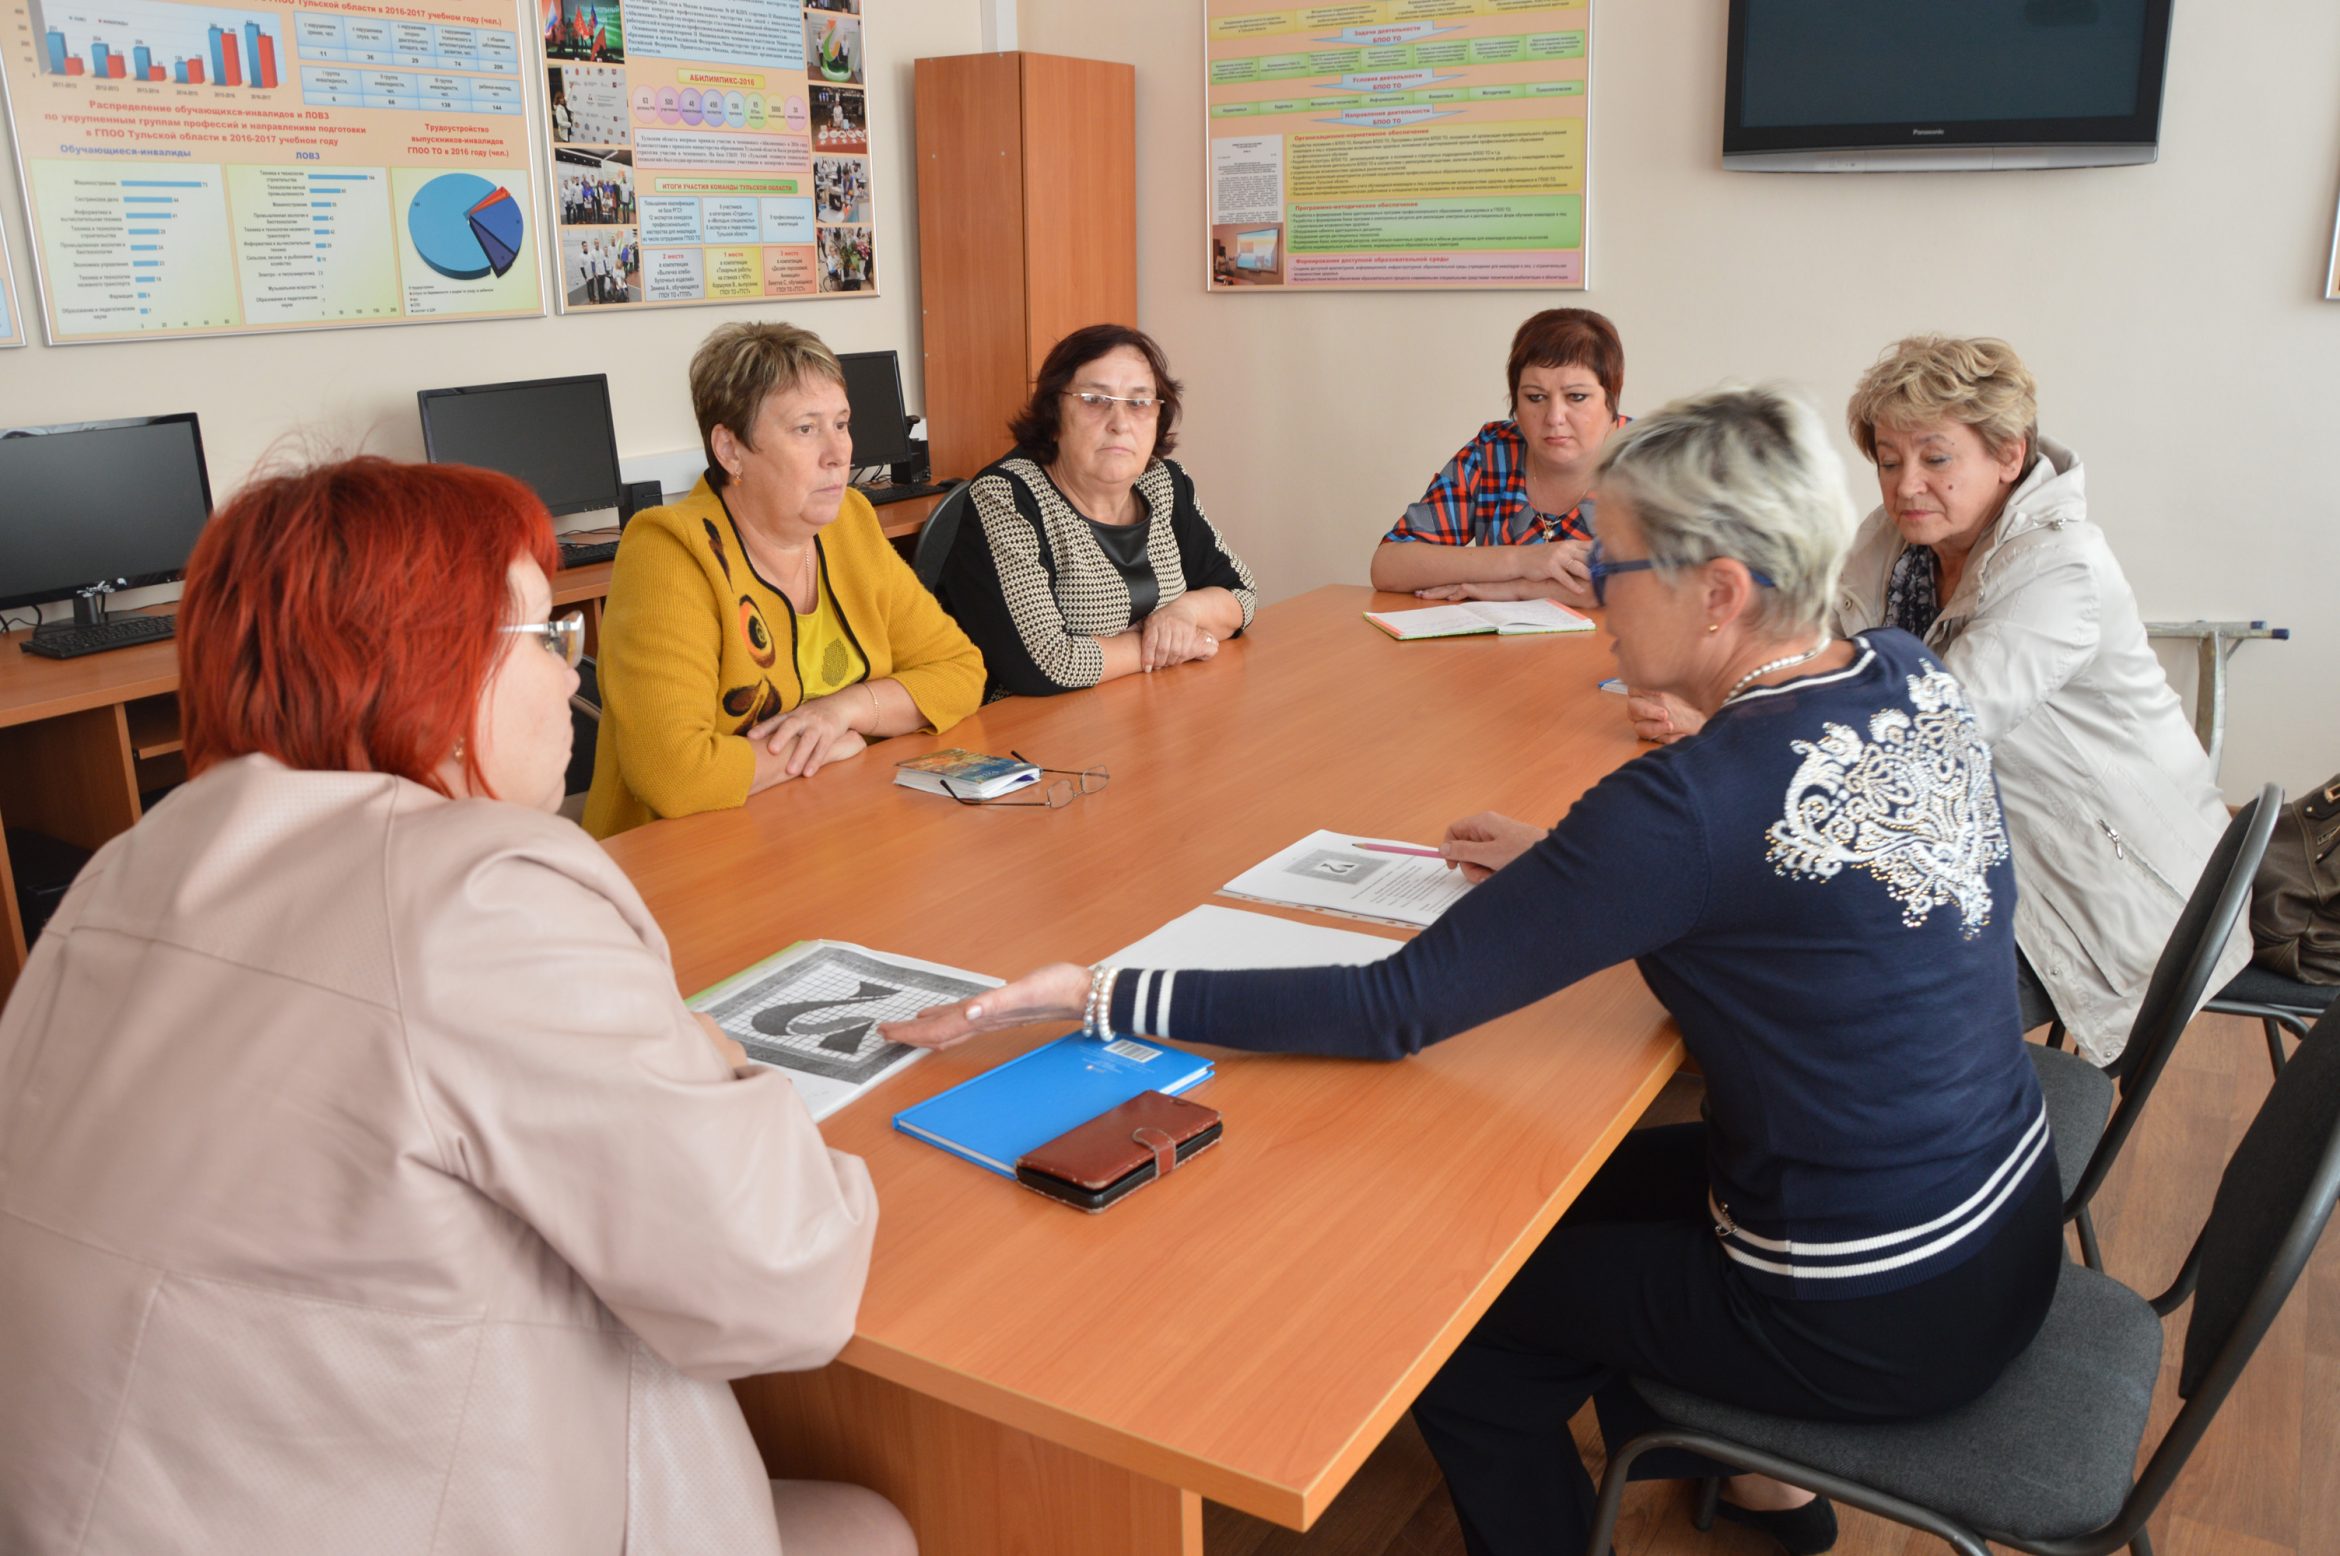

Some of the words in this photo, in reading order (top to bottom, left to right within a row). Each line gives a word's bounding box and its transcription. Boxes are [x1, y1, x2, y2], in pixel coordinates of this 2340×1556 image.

[342, 3, 377, 12] области
[385, 6, 425, 17] 2016-2017
[428, 11, 461, 21] учебном
[463, 16, 480, 25] году
[481, 16, 502, 27] (чел.)
[1355, 27, 1376, 36] Задачи
[1378, 25, 1421, 35] деятельности
[690, 74, 755, 86] АБИЛИМПИКС-2016
[1353, 75, 1378, 84] Условия
[1380, 73, 1423, 83] деятельности
[89, 100, 172, 113] Распределение
[175, 104, 294, 119] обучающихся-инвалидов
[305, 111, 330, 120] ЛОВЗ
[1344, 111, 1386, 120] Направления
[1387, 108, 1430, 117] деятельности
[44, 113, 58, 121] по
[62, 114, 136, 126] укрупненным
[139, 118, 181, 129] группам
[184, 119, 239, 130] профессий
[250, 123, 317, 133] направлениям
[319, 126, 366, 135] подготовки
[424, 123, 490, 134] Трудоустройство
[95, 128, 125, 138] ГПОО
[128, 129, 177, 142] Тульской
[179, 132, 219, 142] области
[230, 134, 276, 144] 2016-2017
[279, 136, 317, 146] учебном
[319, 138, 339, 147] году
[1294, 131, 1386, 141] Организационно-нормативное
[1388, 128, 1429, 136] обеспечение
[1912, 128, 1945, 136] Panasonic
[411, 136, 504, 145] выпускников-инвалидов
[60, 144, 191, 158] Обучающиеся-инвалиды
[295, 151, 321, 160] ЛОВЗ
[407, 146, 430, 155] ГПОО
[432, 147, 443, 155] ТО
[450, 148, 469, 156] 2016
[470, 149, 487, 158] году
[488, 149, 509, 158] (чел.)
[710, 183, 738, 191] КОМАНДЫ
[1295, 203, 1376, 211] Программно-методическое
[1378, 200, 1418, 208] обеспечение
[1341, 257, 1372, 265] доступной
